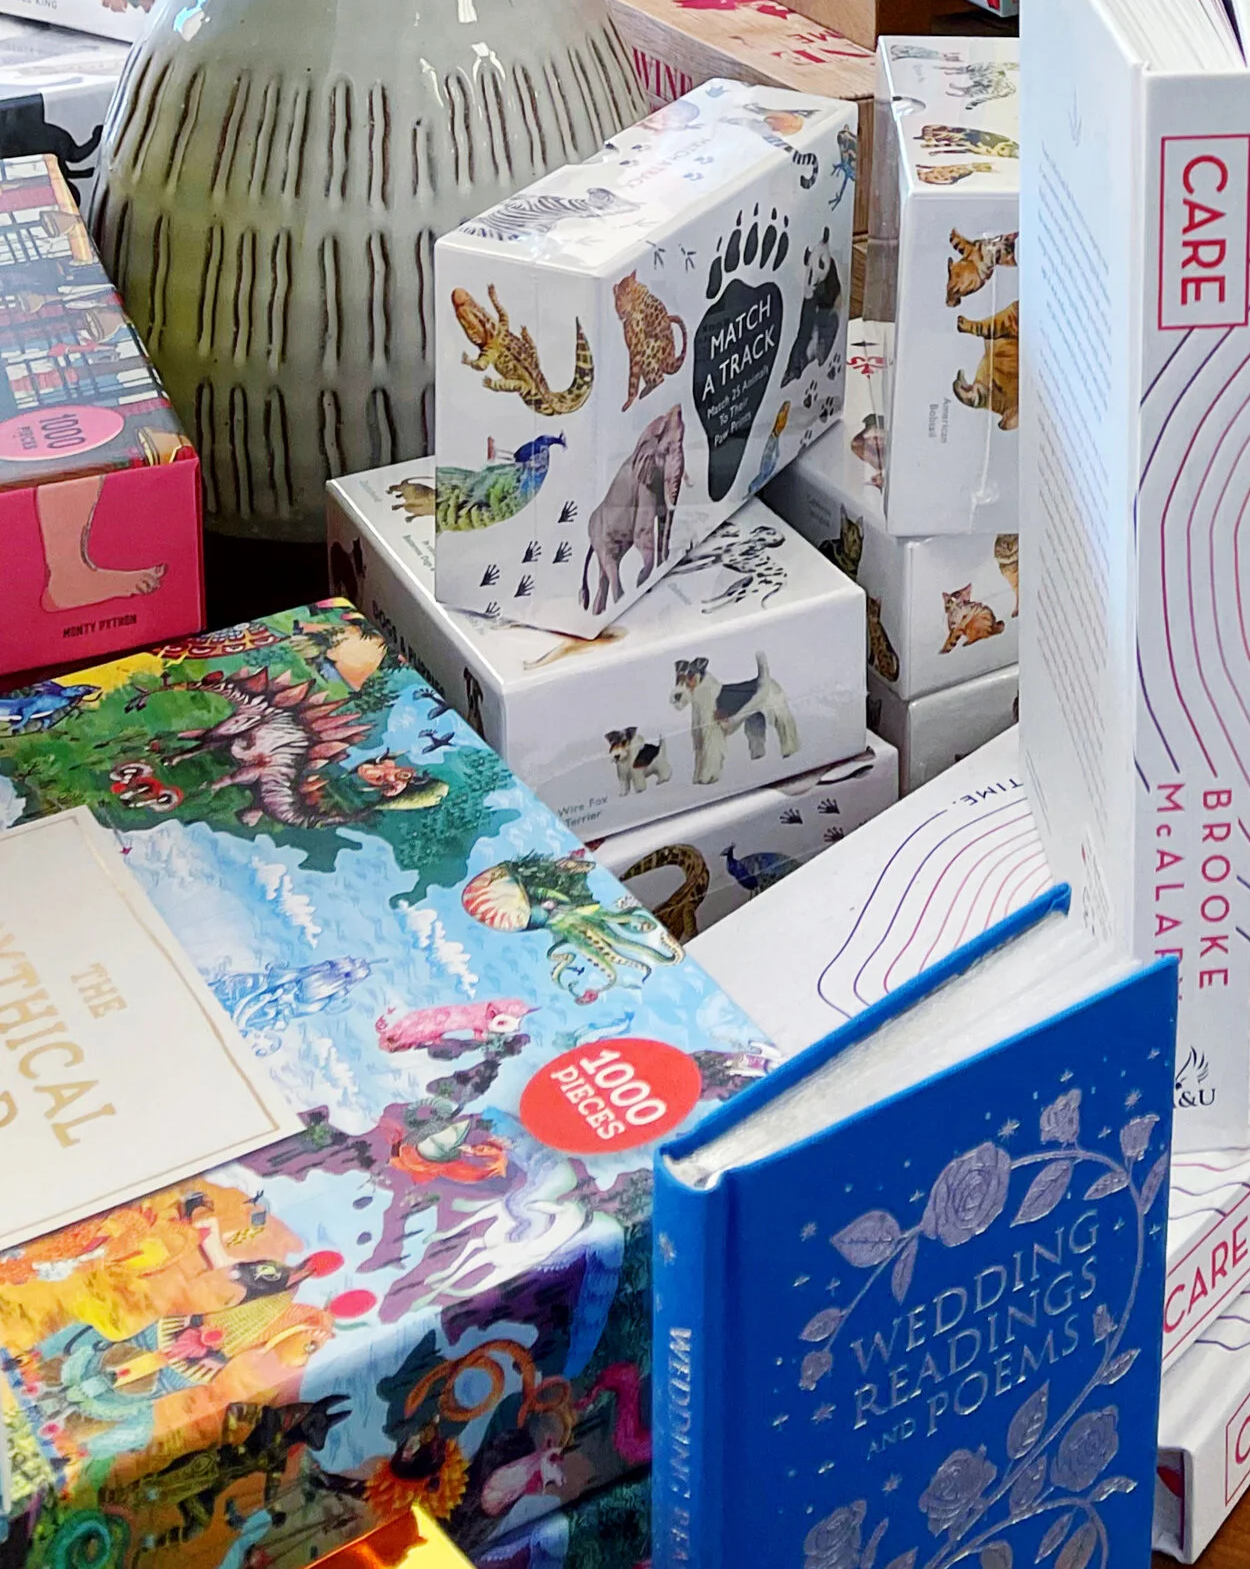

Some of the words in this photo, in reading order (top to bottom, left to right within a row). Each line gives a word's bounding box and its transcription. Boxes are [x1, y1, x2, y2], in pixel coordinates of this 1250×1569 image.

[1180, 152, 1230, 308] CARE
[702, 374, 715, 401] A
[719, 324, 775, 386] TRACK
[710, 294, 771, 361] MATCH
[38, 413, 85, 449] 1000
[62, 619, 97, 639] MONTY
[98, 614, 138, 631] PYTHON
[558, 802, 585, 817] Wire
[589, 794, 609, 808] Fox
[565, 810, 602, 827] Terrier
[1199, 786, 1233, 991] BROOKE
[71, 961, 128, 1020] THE
[549, 1066, 628, 1142] PIECES
[575, 1044, 669, 1129] 1000
[849, 1209, 1099, 1376] WEDDING
[1162, 1215, 1250, 1334] CARE
[853, 1256, 1096, 1431] READINGS
[867, 1416, 916, 1461] AND
[927, 1314, 1079, 1438] POEMS
